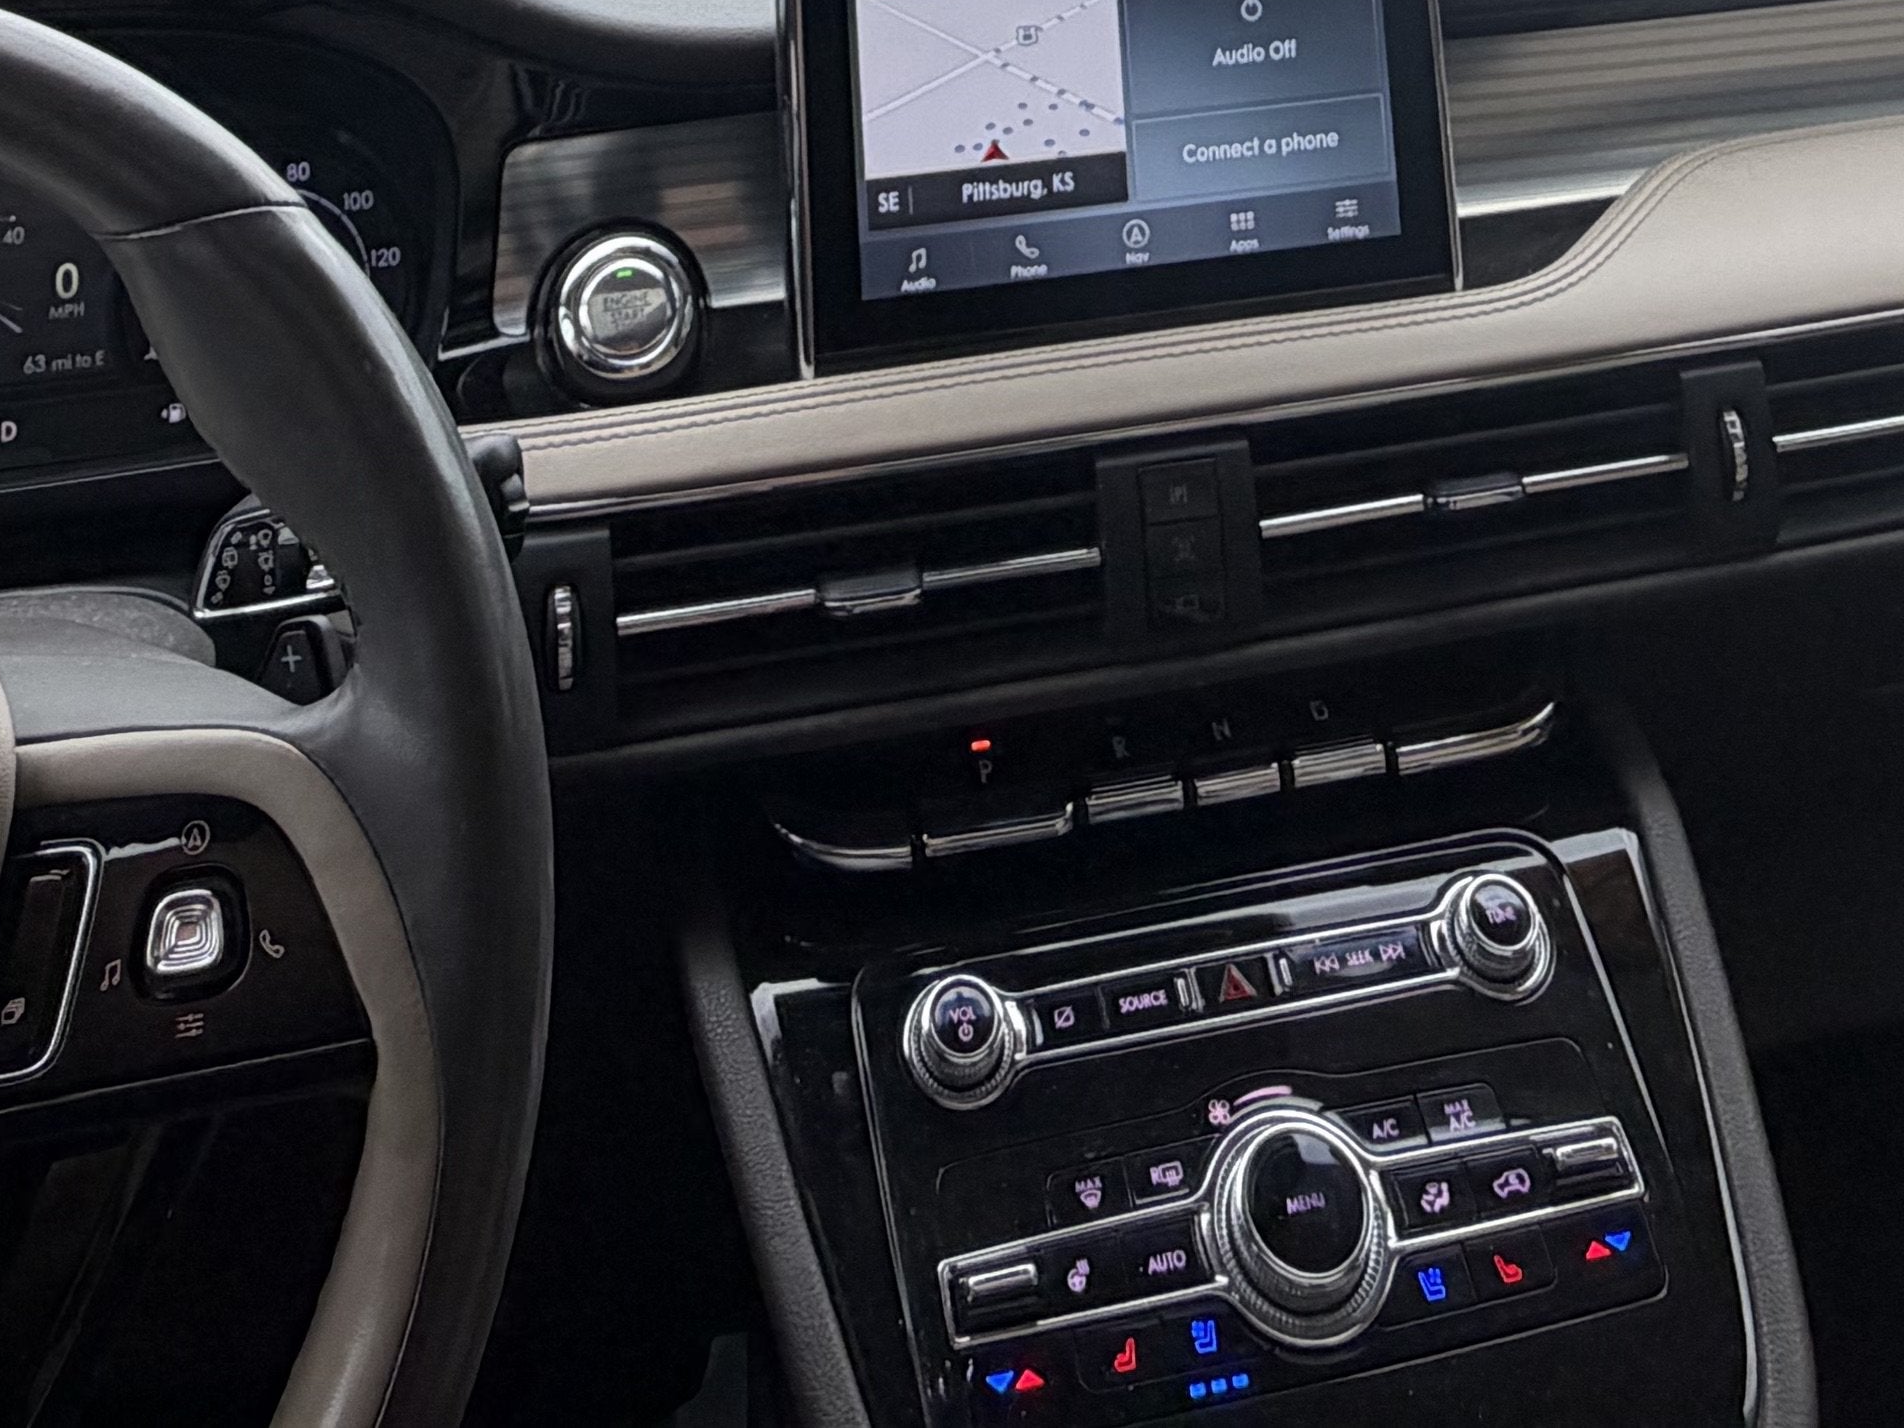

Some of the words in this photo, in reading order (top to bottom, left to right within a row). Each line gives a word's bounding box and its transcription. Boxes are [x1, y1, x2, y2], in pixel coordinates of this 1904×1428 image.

[1212, 41, 1266, 67] Audio
[1268, 38, 1297, 62] Off
[1182, 136, 1260, 164] Connect
[1263, 138, 1278, 154] a
[1281, 130, 1340, 157] phone
[285, 160, 312, 183] 80
[341, 188, 375, 212] 100
[877, 191, 900, 214] SE
[961, 178, 1049, 205] Pittsburg,
[1052, 171, 1075, 193] KS
[1, 225, 27, 246] 40
[369, 245, 402, 269] 120
[900, 276, 937, 293] Audio
[1010, 263, 1049, 280] Phone
[1125, 251, 1150, 265] Nav
[1229, 238, 1260, 254] Apps
[1326, 223, 1371, 242] Settings
[53, 260, 81, 301] 0
[47, 301, 86, 321] MPH
[22, 353, 48, 376] 63
[50, 351, 74, 373] mi
[75, 349, 93, 370] to
[94, 349, 107, 369] E
[0, 419, 19, 445] D
[978, 759, 994, 785] P
[1111, 735, 1131, 760] R
[1210, 718, 1232, 742] N
[1308, 699, 1329, 722] D
[1484, 905, 1517, 926] TUNE
[1345, 948, 1375, 967] SEEK
[1117, 988, 1170, 1016] SOURCE
[949, 1004, 978, 1025] VOL
[1443, 1097, 1472, 1116] MAX
[1371, 1117, 1401, 1140] A/C
[1448, 1109, 1477, 1133] A/C
[1074, 1175, 1103, 1194] MAX
[1285, 1191, 1328, 1217] MENU
[1147, 1248, 1188, 1277] AUTO
